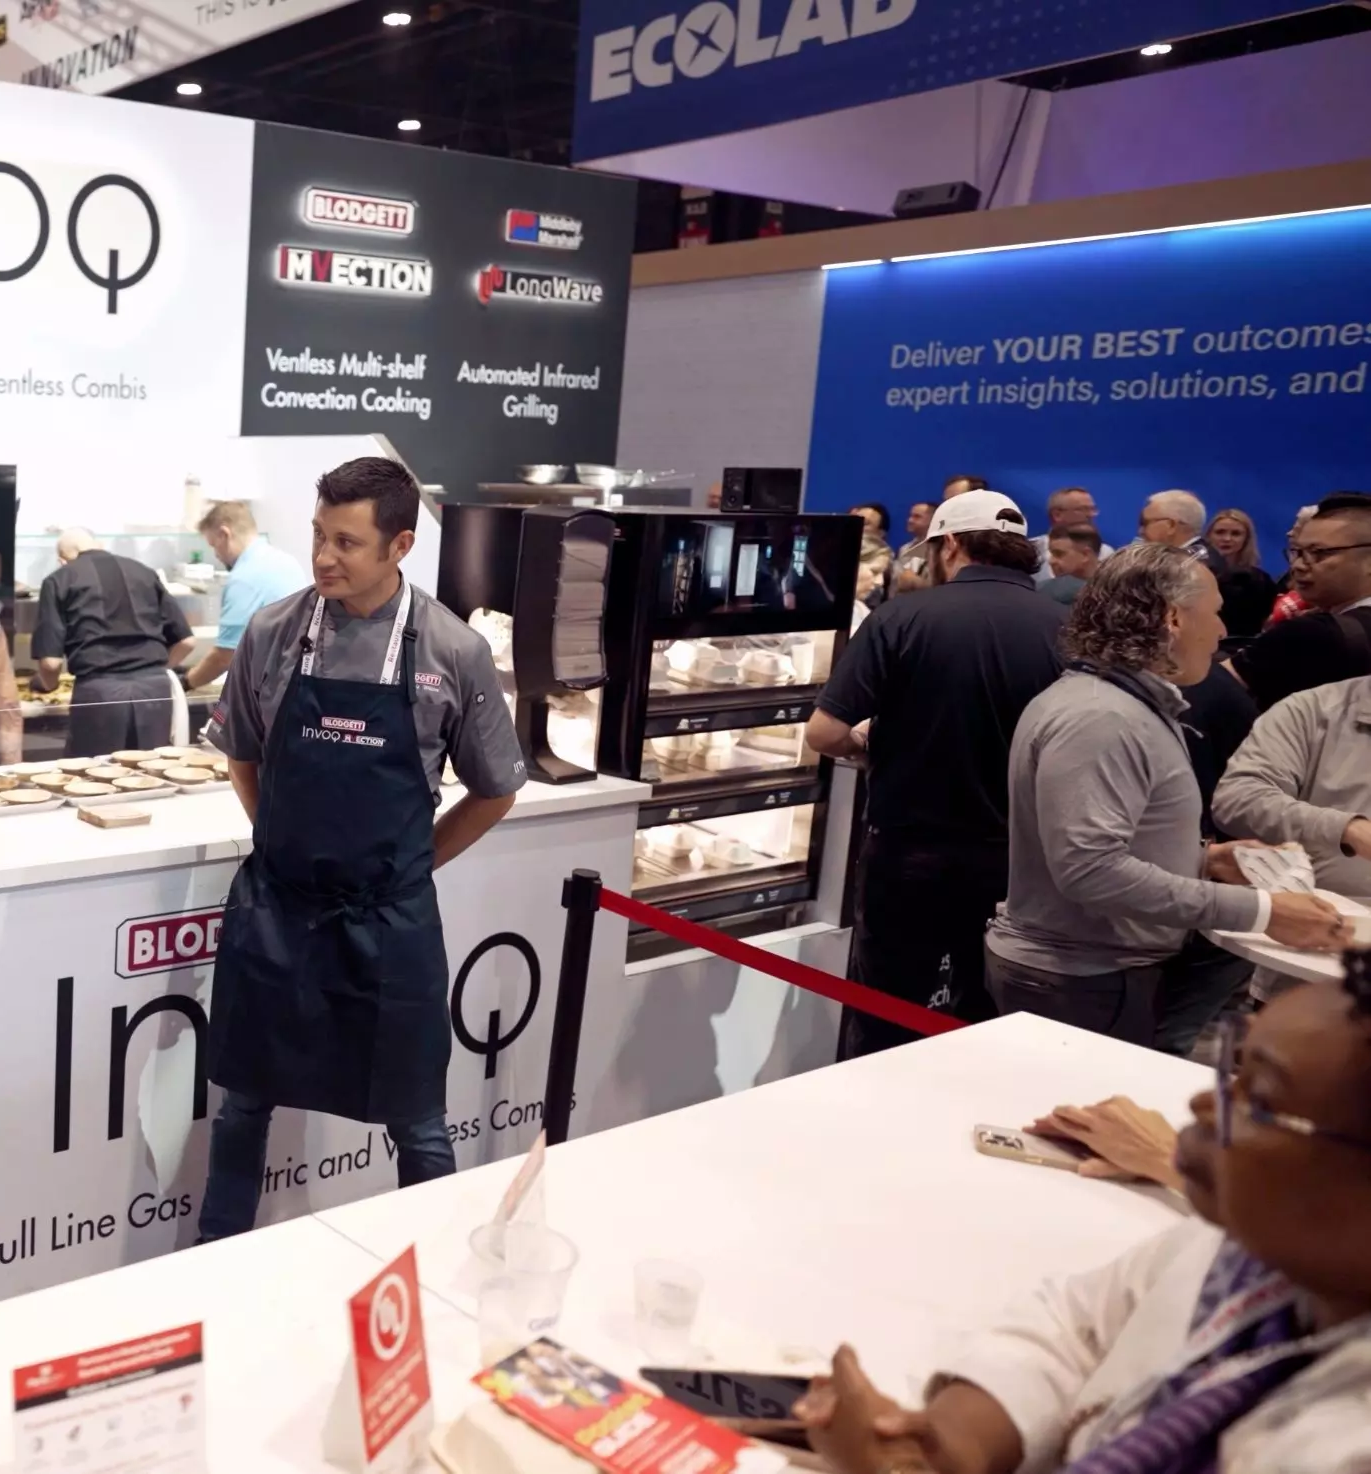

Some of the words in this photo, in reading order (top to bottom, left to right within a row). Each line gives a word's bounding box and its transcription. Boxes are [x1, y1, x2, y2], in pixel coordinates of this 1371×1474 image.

[313, 195, 408, 230] BLODGETT
[506, 271, 603, 303] LongWave
[266, 347, 336, 376] Ventless
[339, 350, 427, 381] Multi-shelf
[890, 341, 985, 370] Deliver
[992, 334, 1083, 364] YOUR
[1092, 328, 1185, 360] BEST
[71, 373, 147, 401] Combis
[457, 361, 541, 388] Automated
[543, 365, 600, 390] Infrared
[885, 379, 970, 411] expert
[977, 374, 1100, 410] insights,
[1109, 369, 1278, 400] solutions,
[1288, 362, 1368, 396] and
[261, 382, 357, 412] Convection
[360, 388, 432, 421] Cooking
[503, 396, 559, 425] Grilling
[133, 919, 222, 965] BLOD
[51, 1212, 115, 1251] Line
[128, 1192, 192, 1228] Gas
[264, 1158, 308, 1193] tric
[318, 1131, 371, 1172] and
[490, 1091, 576, 1131] Coms
